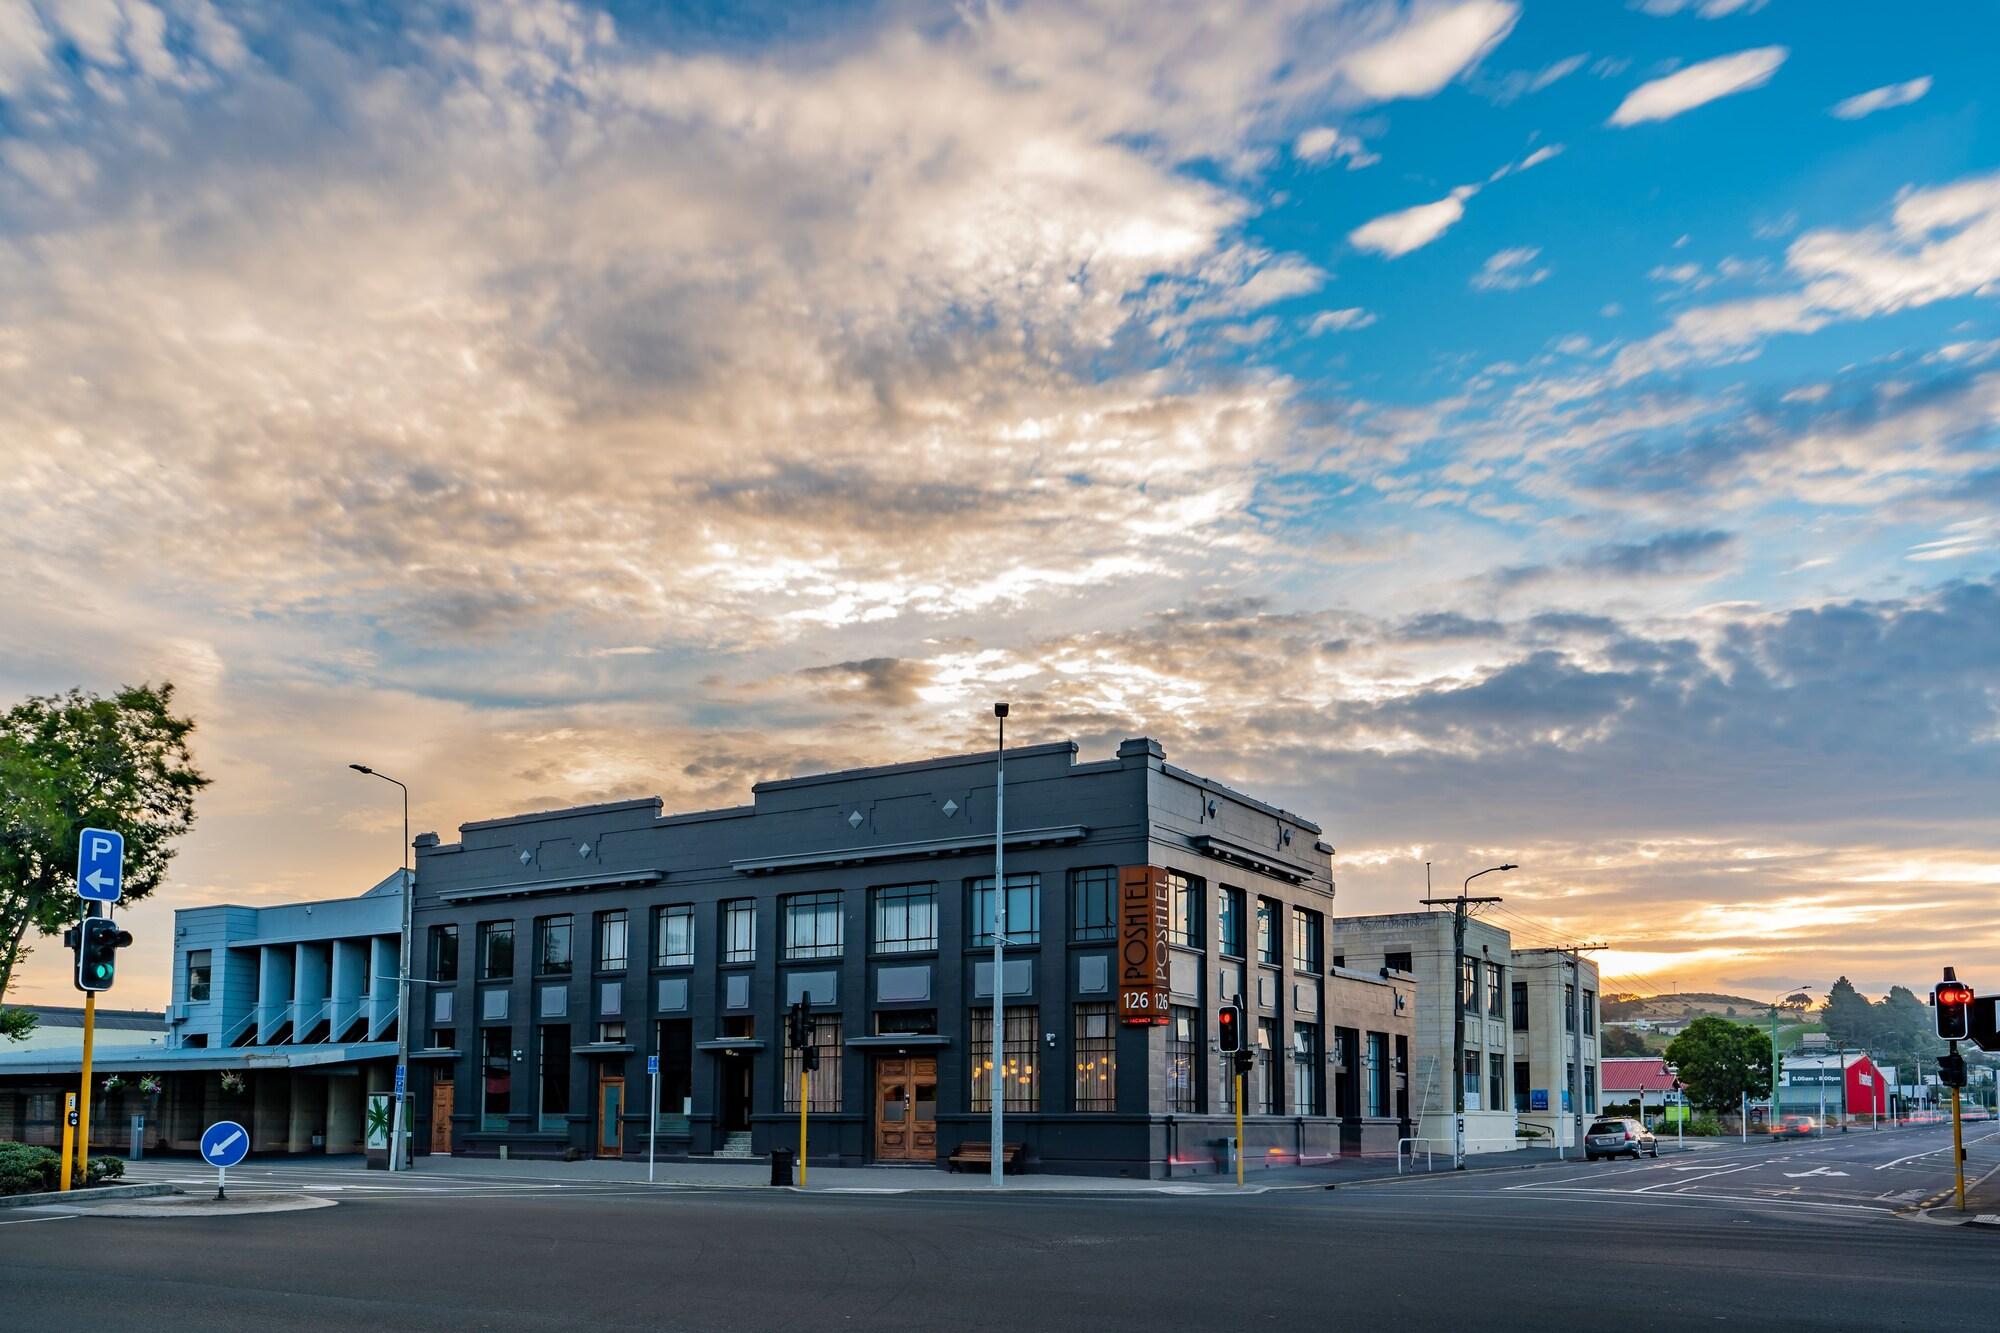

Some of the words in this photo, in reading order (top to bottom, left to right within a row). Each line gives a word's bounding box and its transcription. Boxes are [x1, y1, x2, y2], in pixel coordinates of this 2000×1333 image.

[92, 837, 112, 861] P
[1124, 872, 1148, 979] POSHTEL
[1155, 875, 1167, 980] POSHTEL
[1124, 992, 1149, 1009] 126
[1155, 993, 1168, 1010] 126
